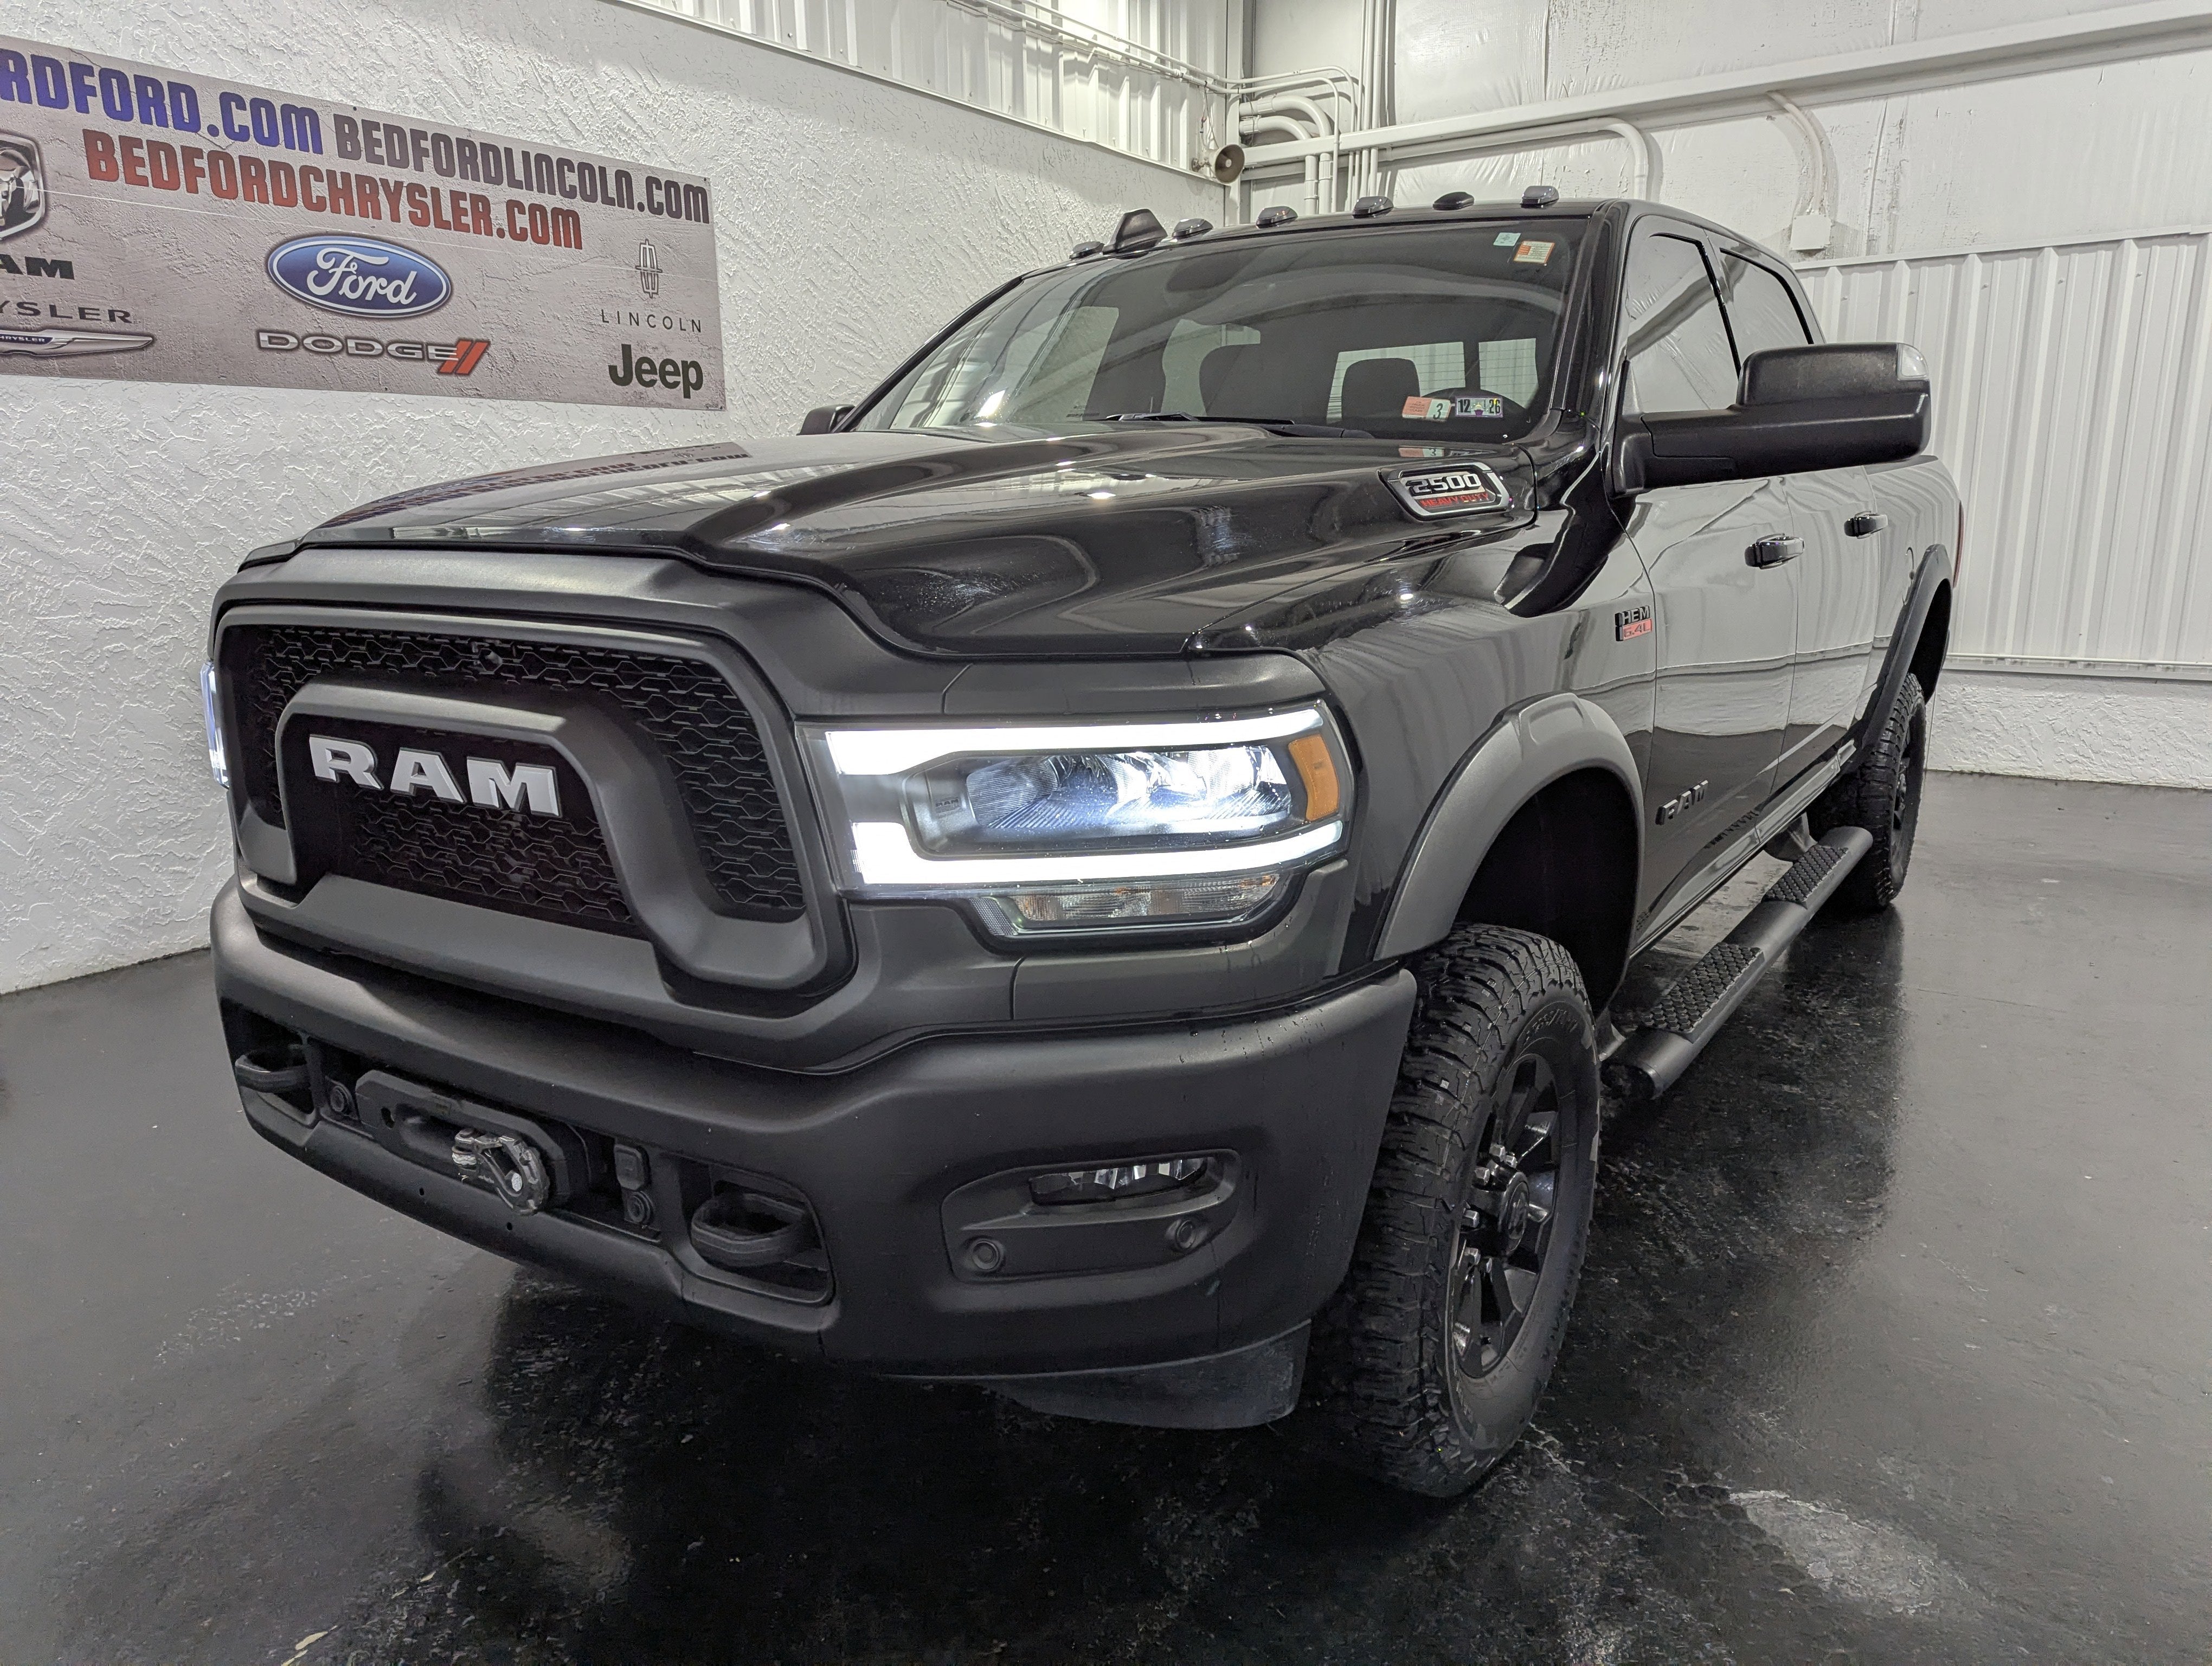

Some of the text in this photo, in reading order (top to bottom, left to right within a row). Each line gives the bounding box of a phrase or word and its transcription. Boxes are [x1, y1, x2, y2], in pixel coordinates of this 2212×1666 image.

[82, 129, 583, 250] BEDFORDCHRYSLER.COM
[333, 113, 710, 224] BEDFORDLINCOLN.COM
[306, 247, 417, 305] Ford
[258, 332, 459, 362] DODGE
[601, 309, 701, 332] LINCOLN
[608, 343, 704, 399] Jeep
[1458, 399, 1471, 413] 12
[1405, 473, 1482, 496] 2500
[308, 733, 562, 818] RAM
